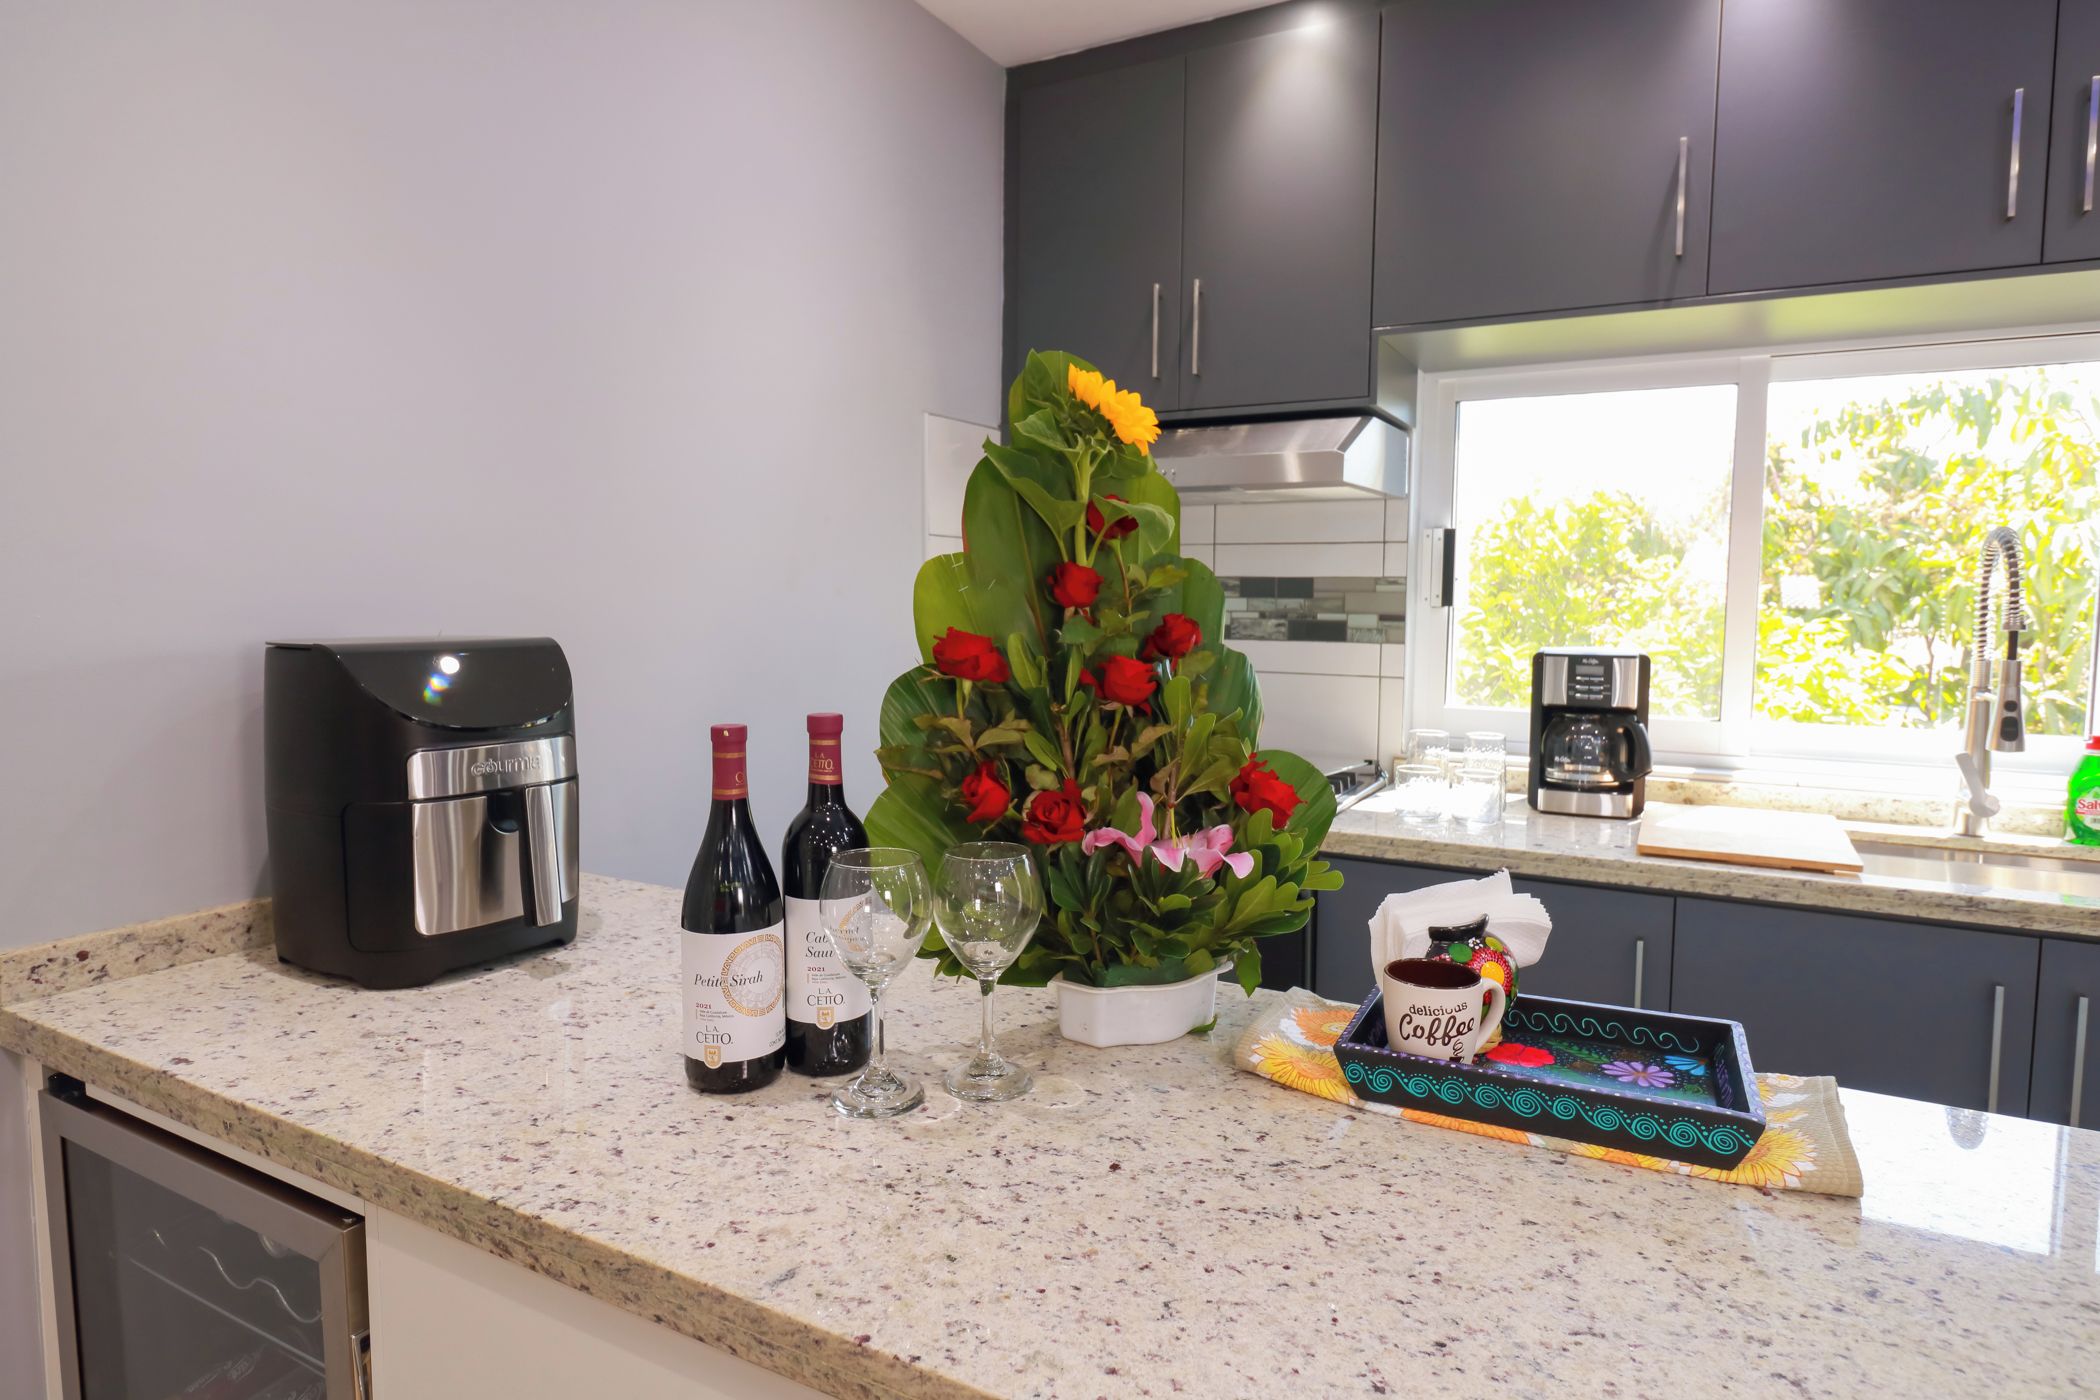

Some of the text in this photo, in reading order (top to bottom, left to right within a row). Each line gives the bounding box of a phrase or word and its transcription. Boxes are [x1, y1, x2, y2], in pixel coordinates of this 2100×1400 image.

[471, 755, 542, 776] Gourmia
[2078, 799, 2100, 810] Sal
[694, 970, 763, 988] Petite Sirah
[818, 987, 832, 995] LA
[695, 1002, 712, 1010] 2021
[806, 993, 844, 1007] CETTO
[1408, 1002, 1468, 1017] delicious
[705, 1024, 719, 1033] LA
[1399, 1013, 1475, 1047] Coffee
[696, 1031, 732, 1045] CETTO
